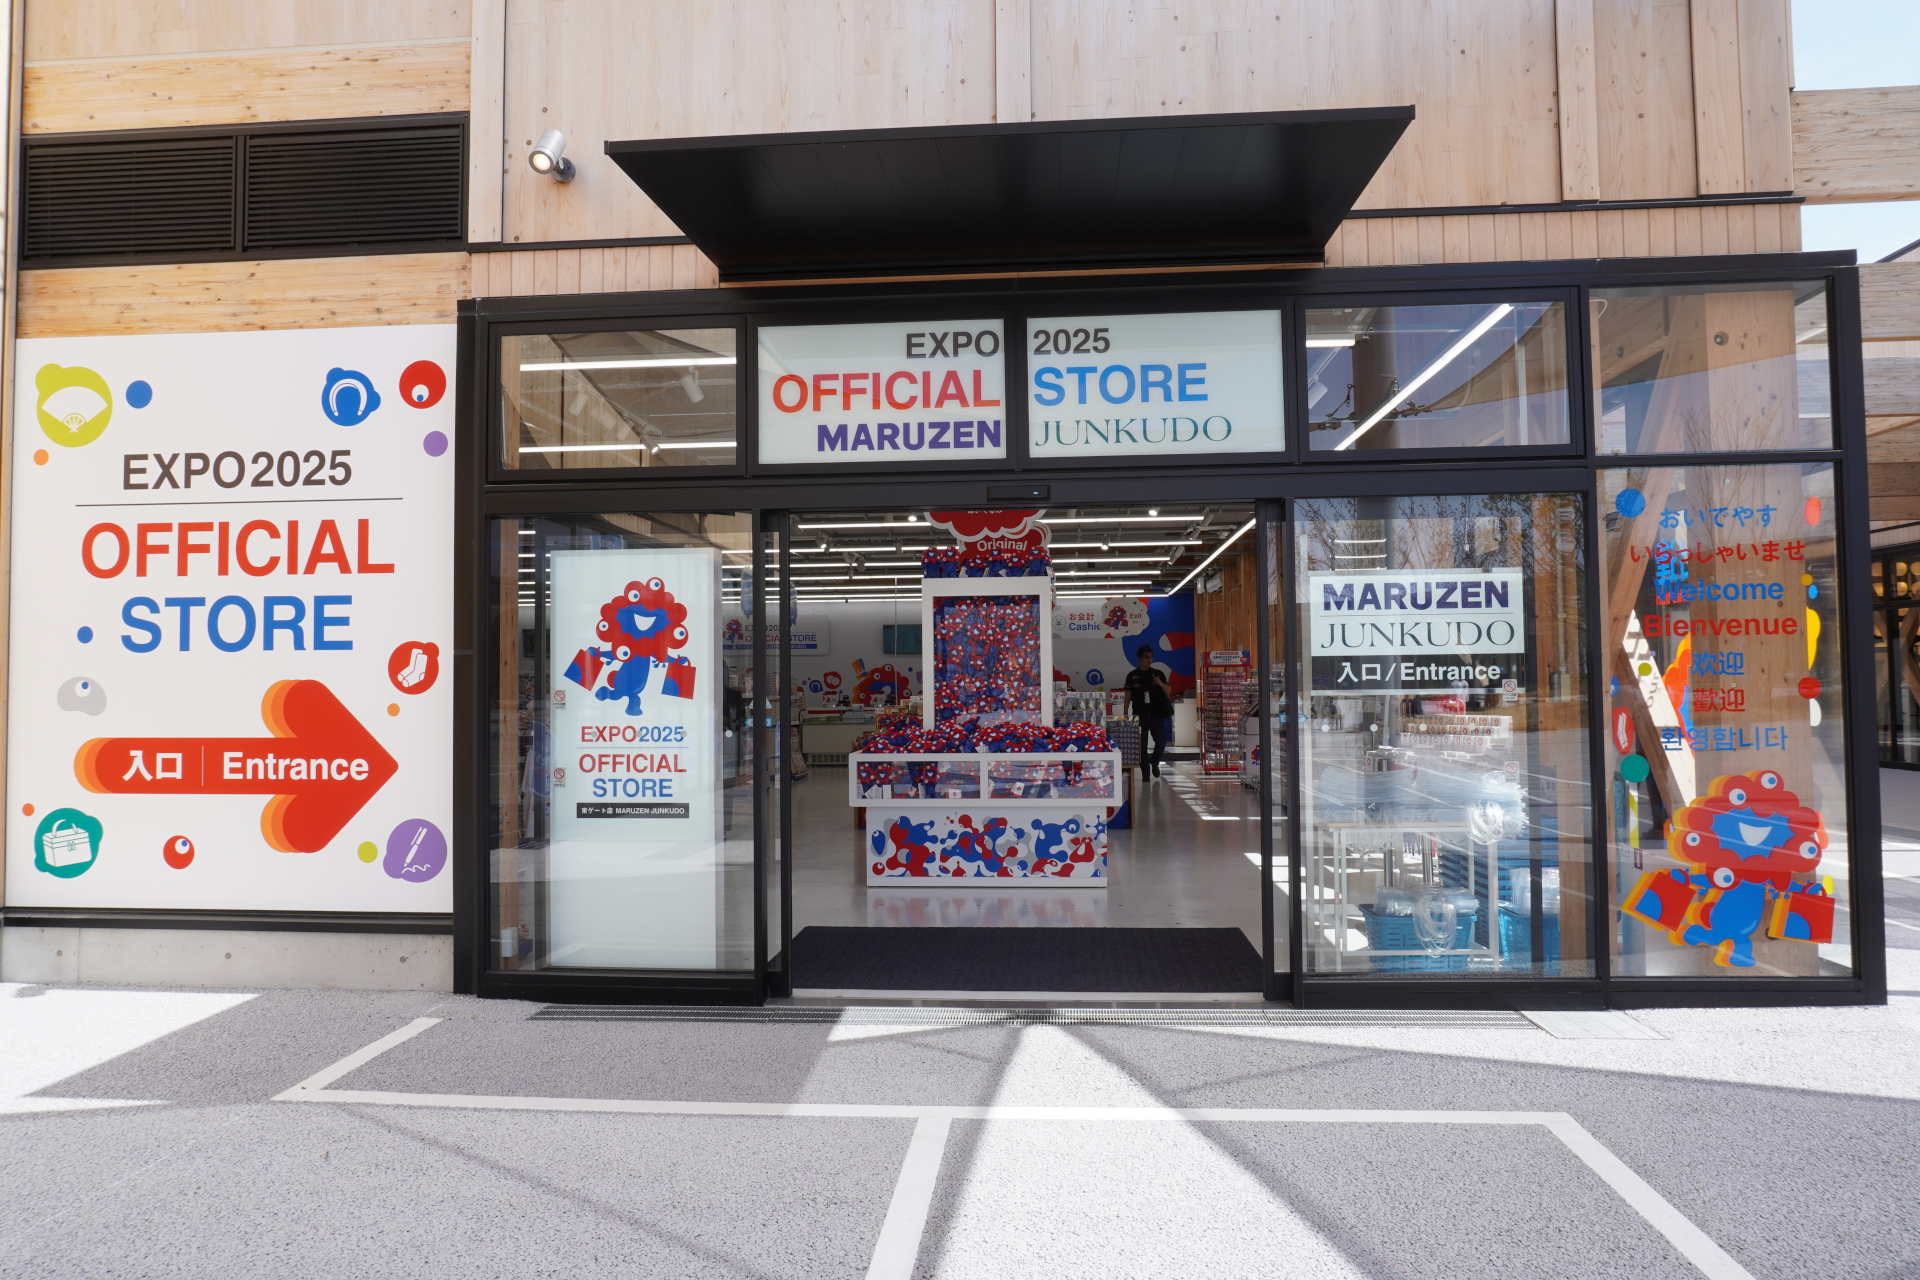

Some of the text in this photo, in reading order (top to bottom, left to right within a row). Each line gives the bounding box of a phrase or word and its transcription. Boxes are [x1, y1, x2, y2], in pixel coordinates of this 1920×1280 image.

[907, 328, 1111, 359] EXPO 2025
[772, 363, 1209, 414] OFFICIAL STORE
[817, 415, 1232, 452] MARUZEN JUNKUDO
[122, 449, 353, 491] EXPO2025
[1658, 504, 1777, 529] おいでやす
[81, 518, 396, 579] OFFICIAL
[977, 538, 1028, 551] Original
[1630, 540, 1806, 564] いらっしゃいませ
[1323, 580, 1509, 611] MARUZEN
[1653, 578, 1784, 602] Welcome
[120, 594, 354, 654] STORE
[1069, 612, 1095, 621] お会計
[1642, 614, 1798, 638] Bienvenue
[1320, 619, 1515, 649] JUNKUDO
[1691, 651, 1745, 676] 欢迎
[1691, 687, 1746, 713] 歡迎
[581, 726, 685, 743] EXPO2025
[1660, 726, 1788, 751] 환영합니다
[122, 750, 370, 782] 入口 Entrance
[578, 753, 687, 774] OFFICIAL
[592, 777, 674, 798] STORE
[581, 806, 685, 815] 東ゲート店 MARUZEN JUNKUDO
